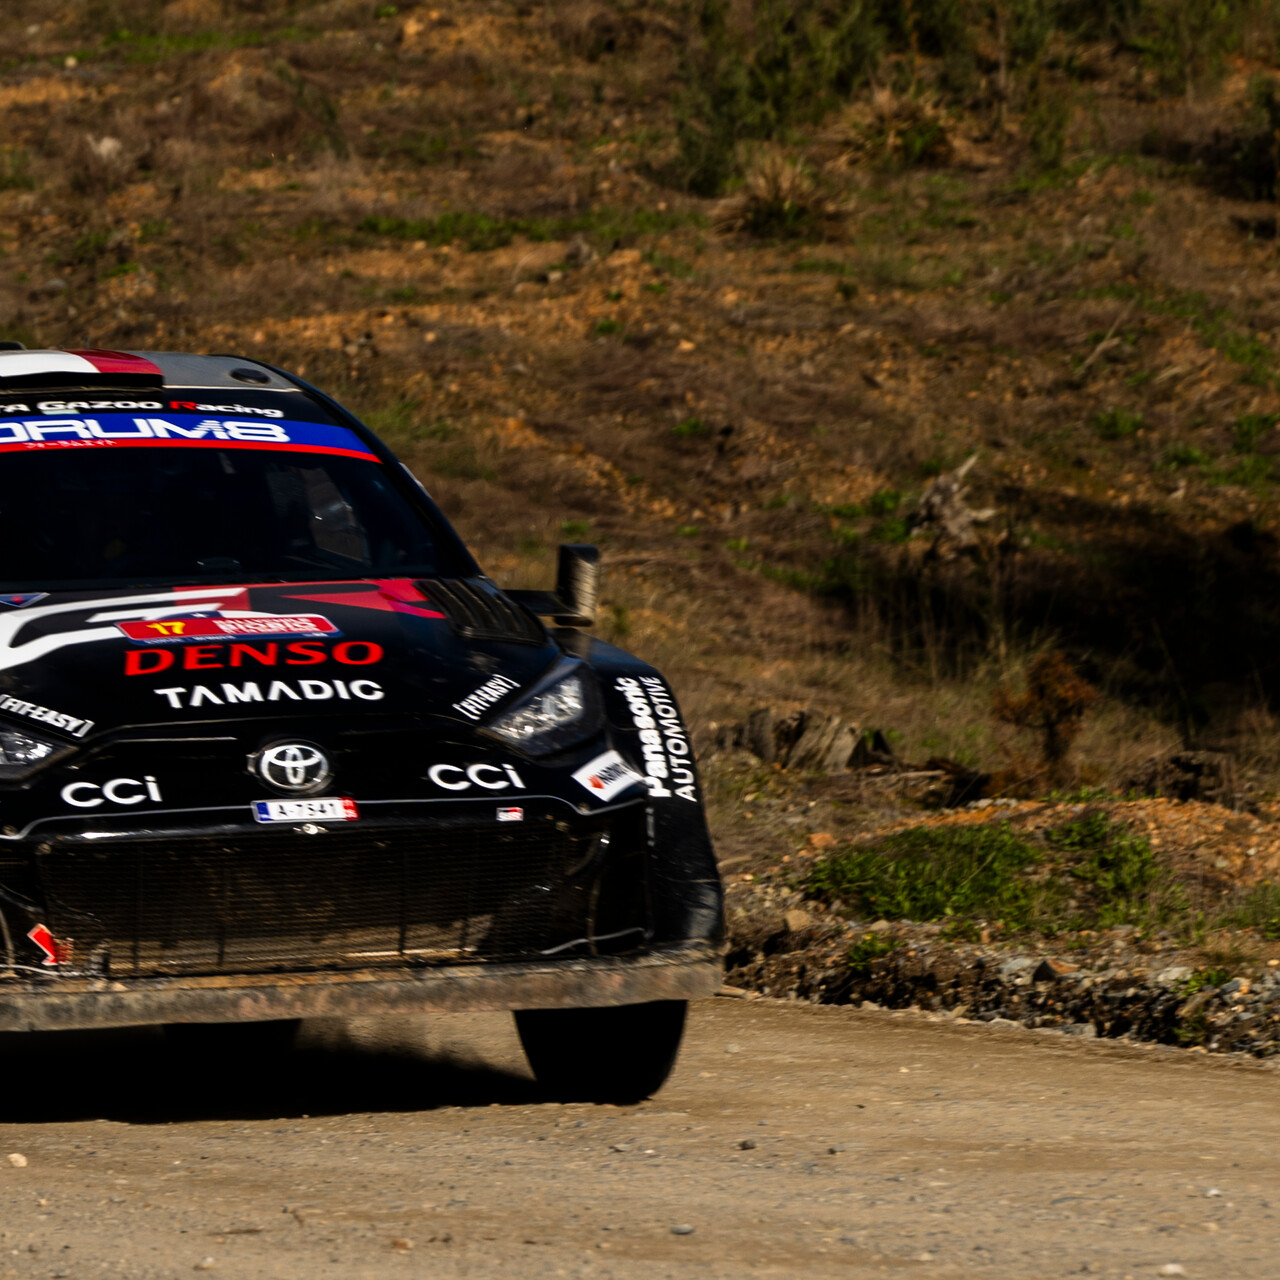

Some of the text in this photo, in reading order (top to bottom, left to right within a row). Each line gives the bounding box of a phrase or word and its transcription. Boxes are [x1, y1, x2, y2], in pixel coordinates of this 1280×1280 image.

[37, 400, 163, 411] GAZOO
[169, 400, 285, 418] Racing
[146, 621, 187, 635] 17
[124, 640, 384, 676] DENSO
[153, 679, 386, 709] TAMADIC
[615, 676, 672, 797] Panasonic
[639, 676, 697, 802] AUTOMOTIVE
